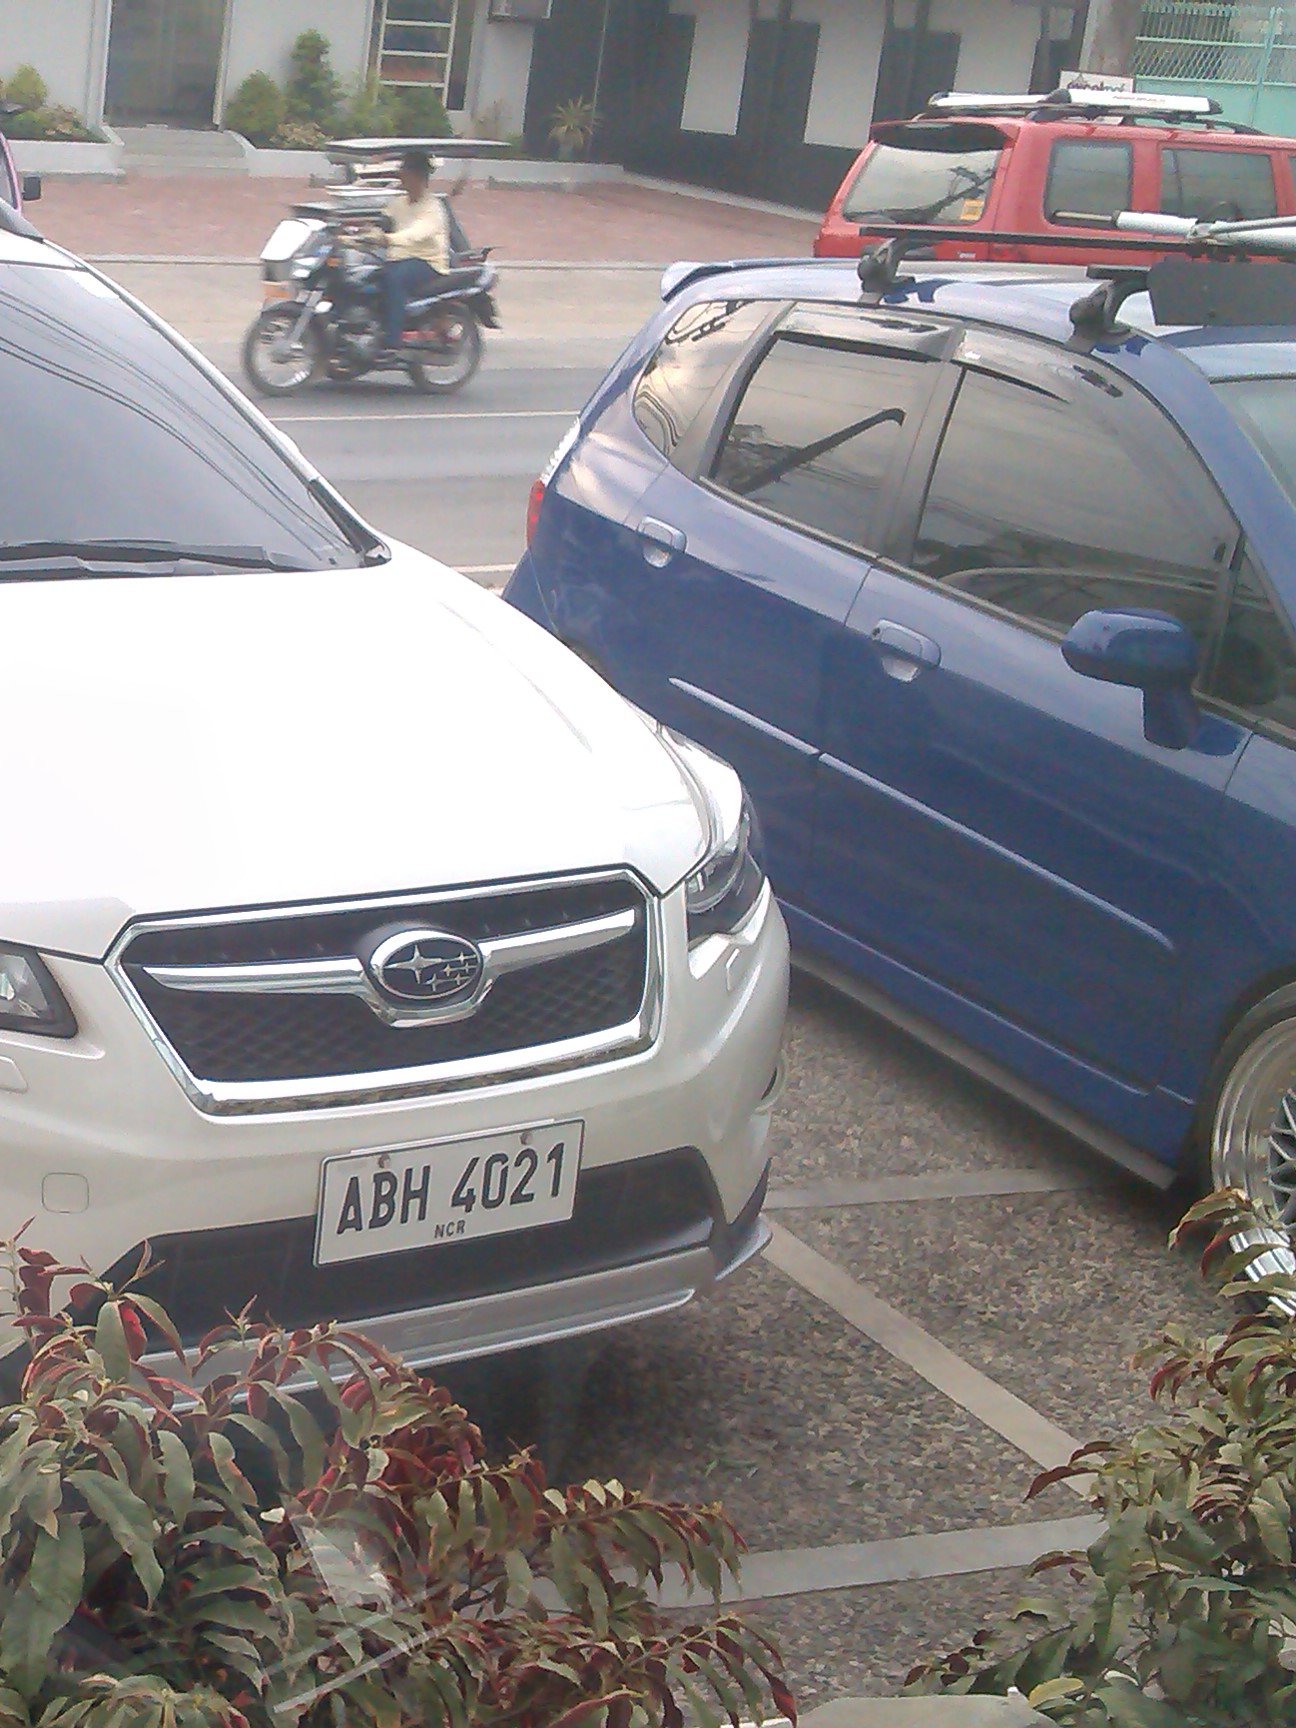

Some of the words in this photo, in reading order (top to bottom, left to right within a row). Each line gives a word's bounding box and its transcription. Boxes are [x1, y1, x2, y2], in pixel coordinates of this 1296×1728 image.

[336, 1164, 431, 1235] ABH
[450, 1141, 565, 1213] 4021
[434, 1220, 466, 1239] NCR
